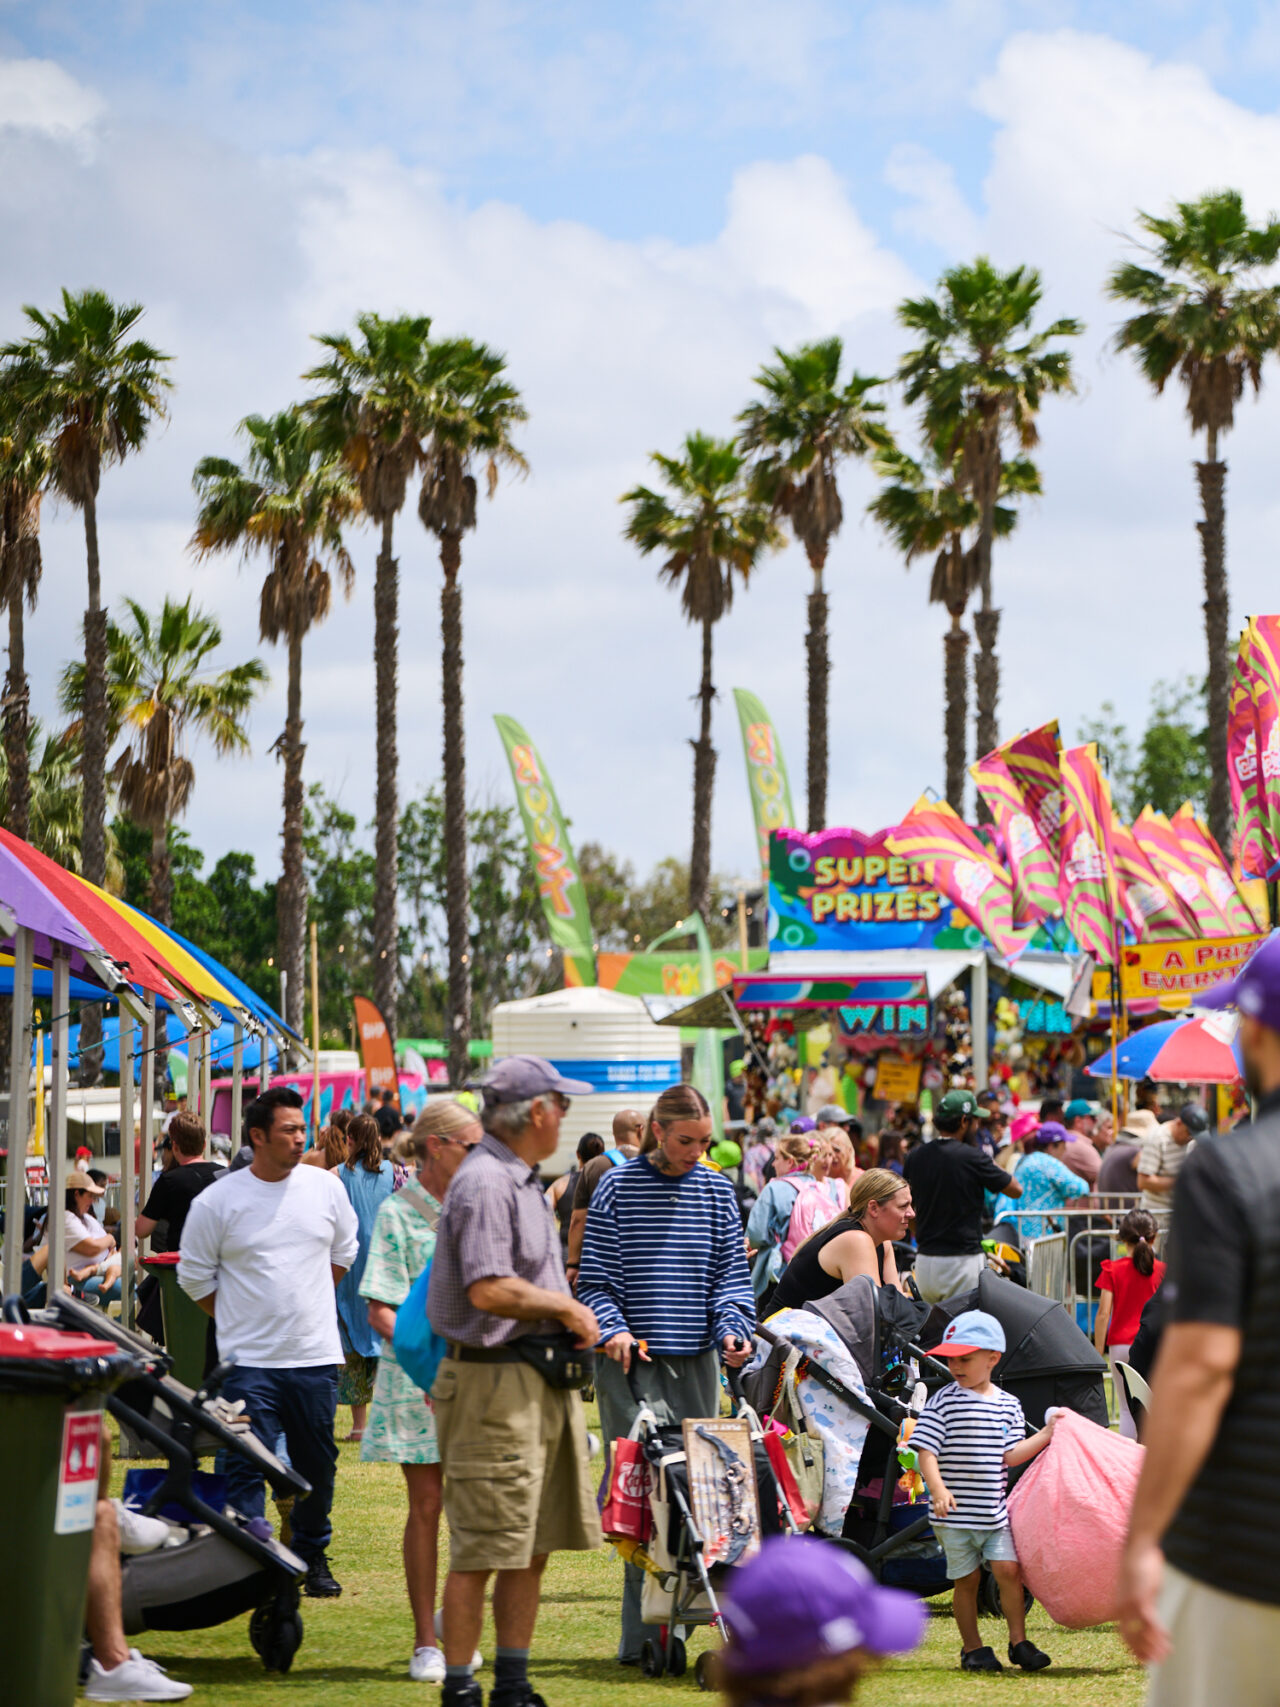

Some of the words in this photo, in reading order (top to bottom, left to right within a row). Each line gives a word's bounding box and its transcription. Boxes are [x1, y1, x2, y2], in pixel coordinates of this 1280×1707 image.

[811, 890, 942, 923] PRIZES
[1163, 951, 1186, 969] A
[1195, 941, 1257, 966] PRIZ
[839, 1003, 928, 1031] WIN
